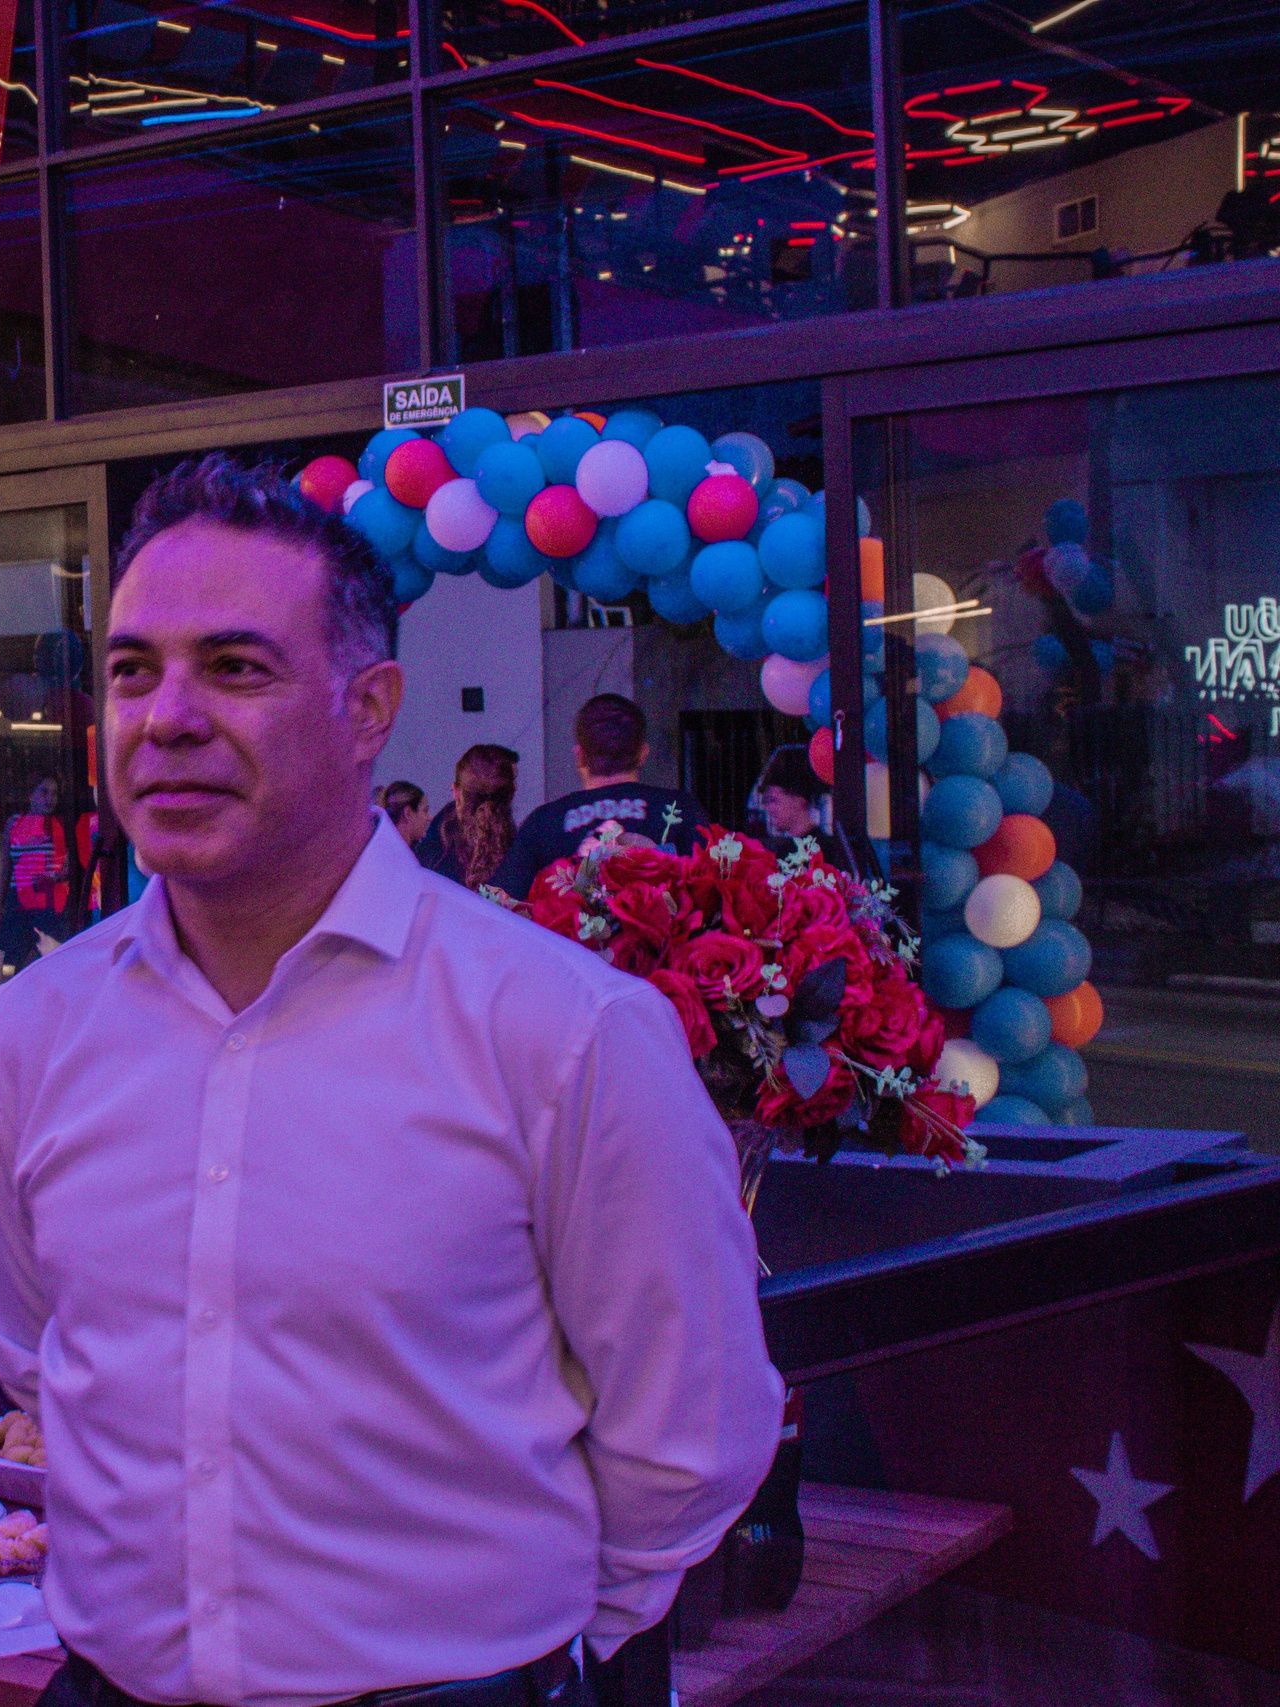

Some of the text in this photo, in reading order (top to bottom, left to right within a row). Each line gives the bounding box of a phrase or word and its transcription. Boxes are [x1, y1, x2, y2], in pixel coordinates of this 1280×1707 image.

[395, 384, 453, 410] SAÍDA
[389, 405, 459, 423] DE EMERGÊNCIA
